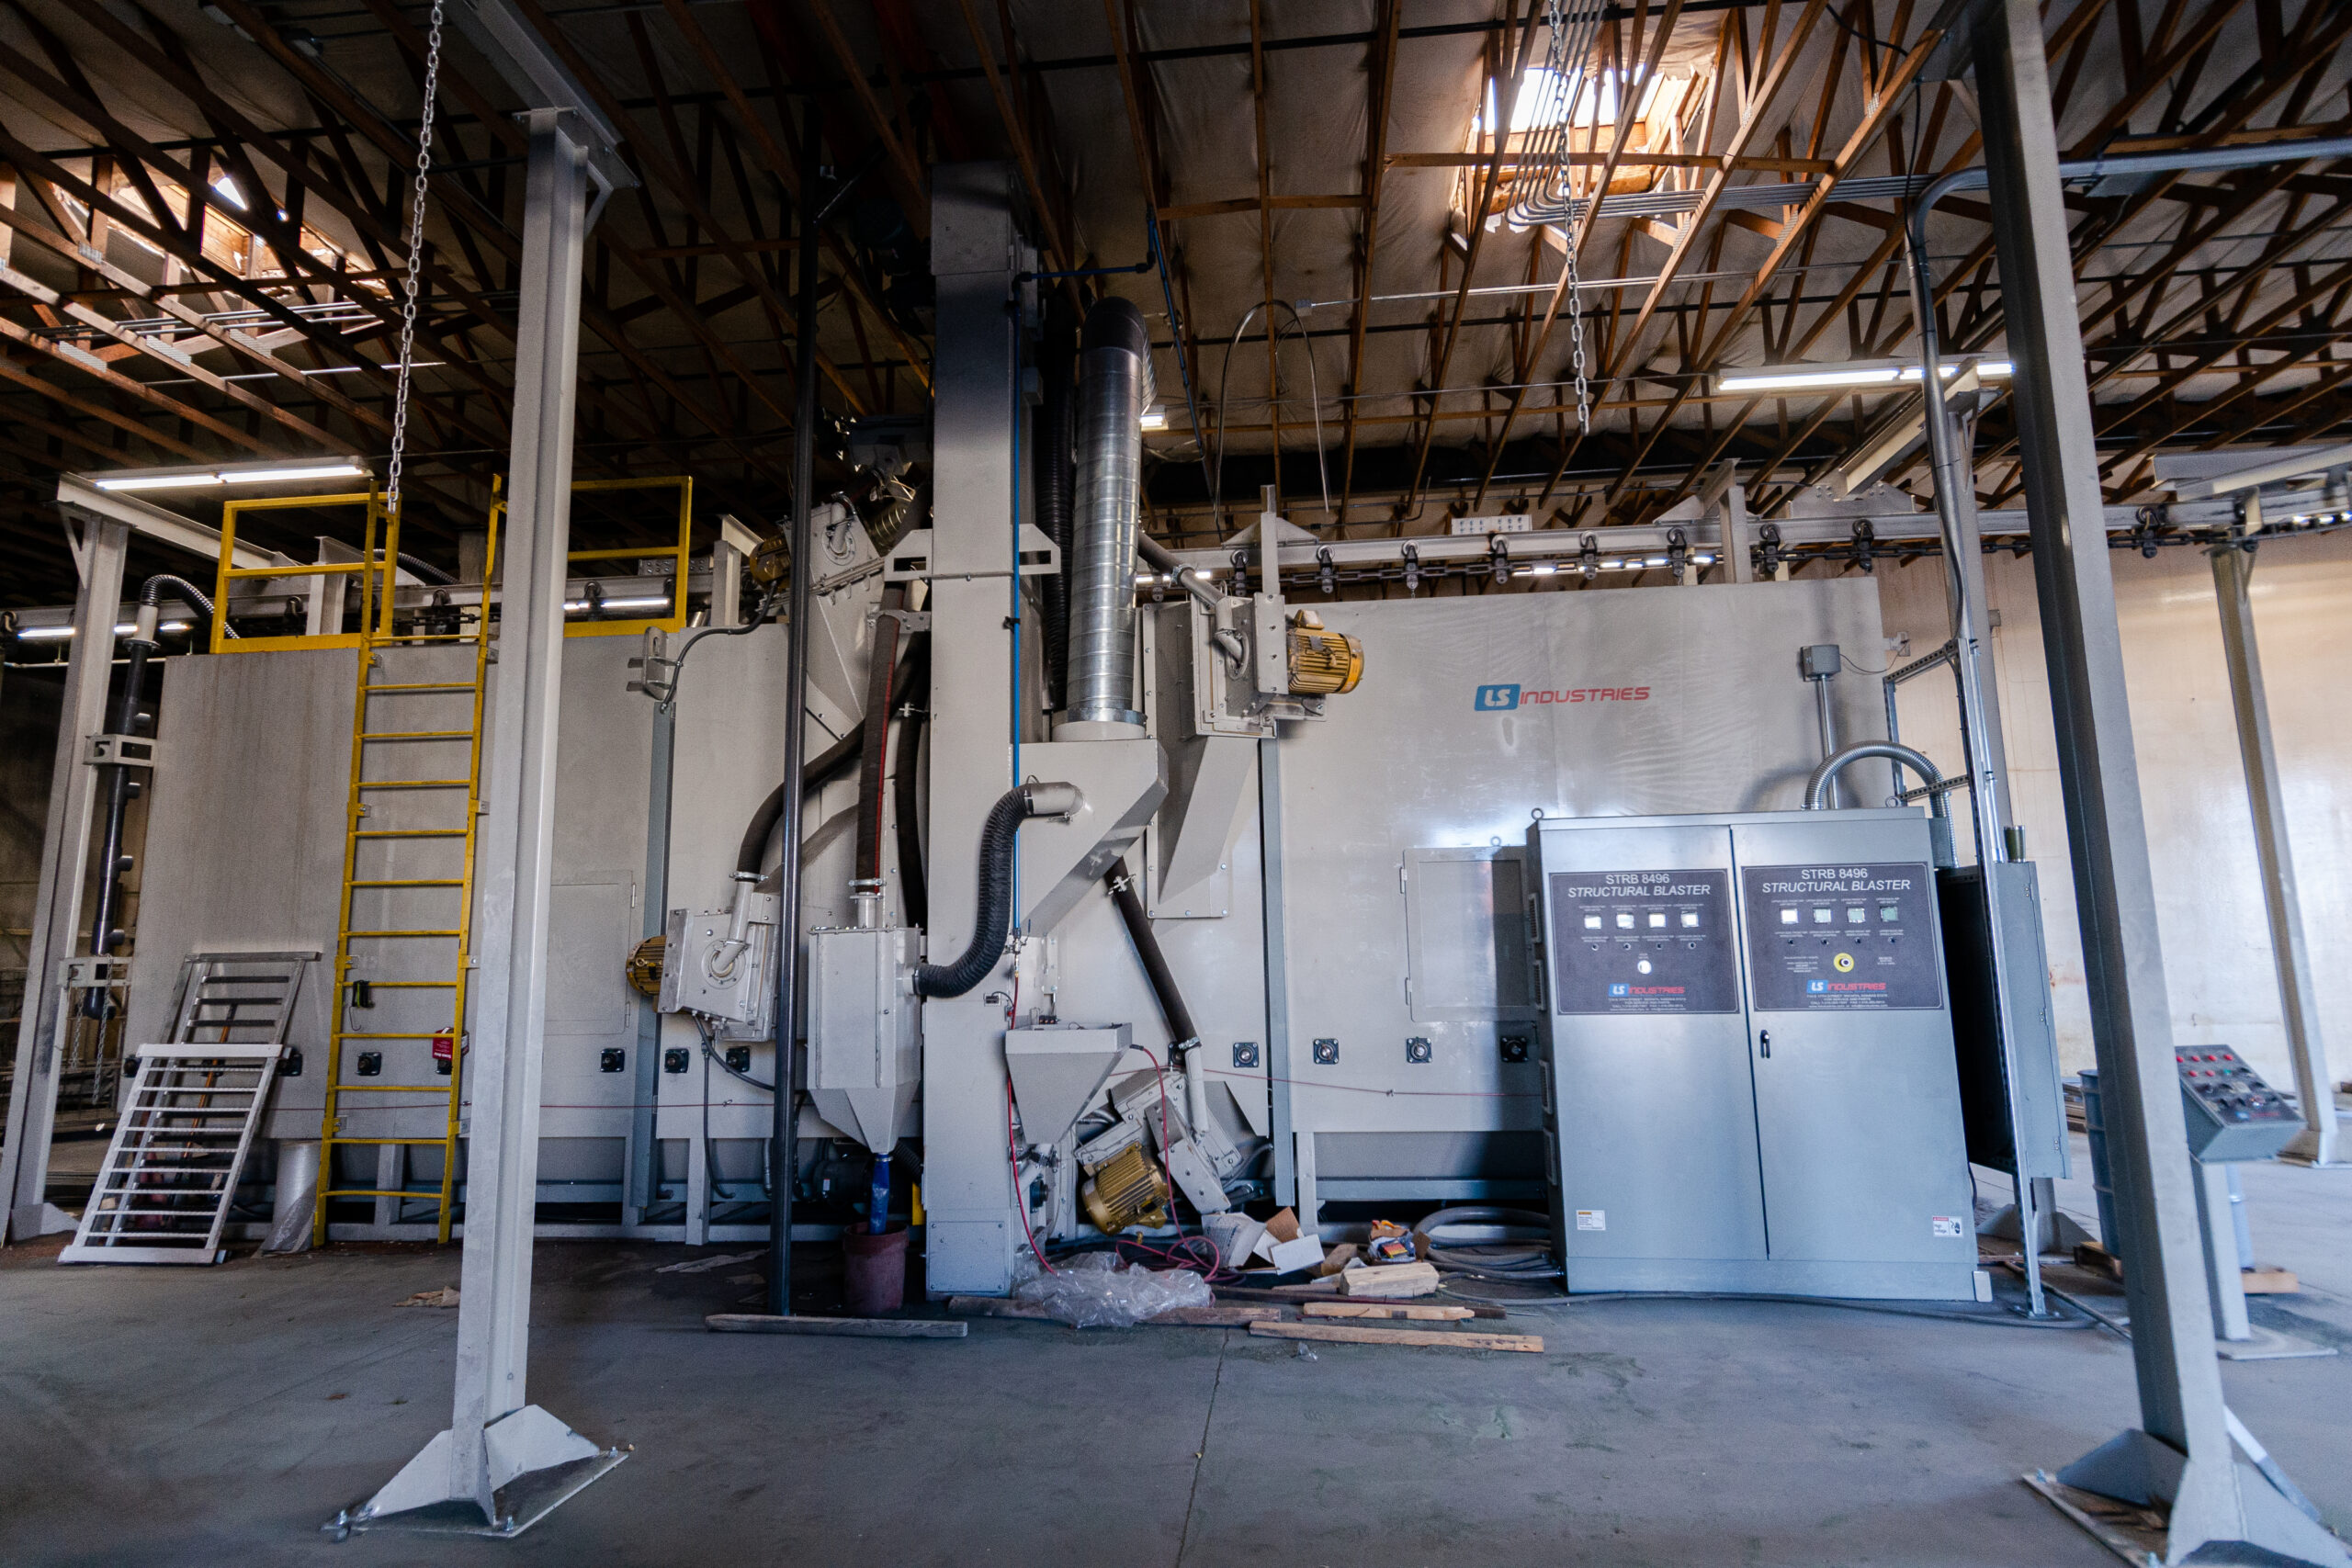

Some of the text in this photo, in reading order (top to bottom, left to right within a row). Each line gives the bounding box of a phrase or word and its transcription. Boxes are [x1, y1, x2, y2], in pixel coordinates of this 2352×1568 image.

[1484, 686, 1651, 707] LS INDUSTRIES
[1605, 874, 1670, 885] STRB 8496
[1801, 867, 1868, 880] STRB 8496
[1567, 885, 1711, 897] STRUCTURAL BLASTER
[1762, 879, 1911, 893] STRUCTURAL BLASTER
[1629, 986, 1685, 995] INDUSTRIES
[1827, 982, 1886, 991] INDUSTRIES
